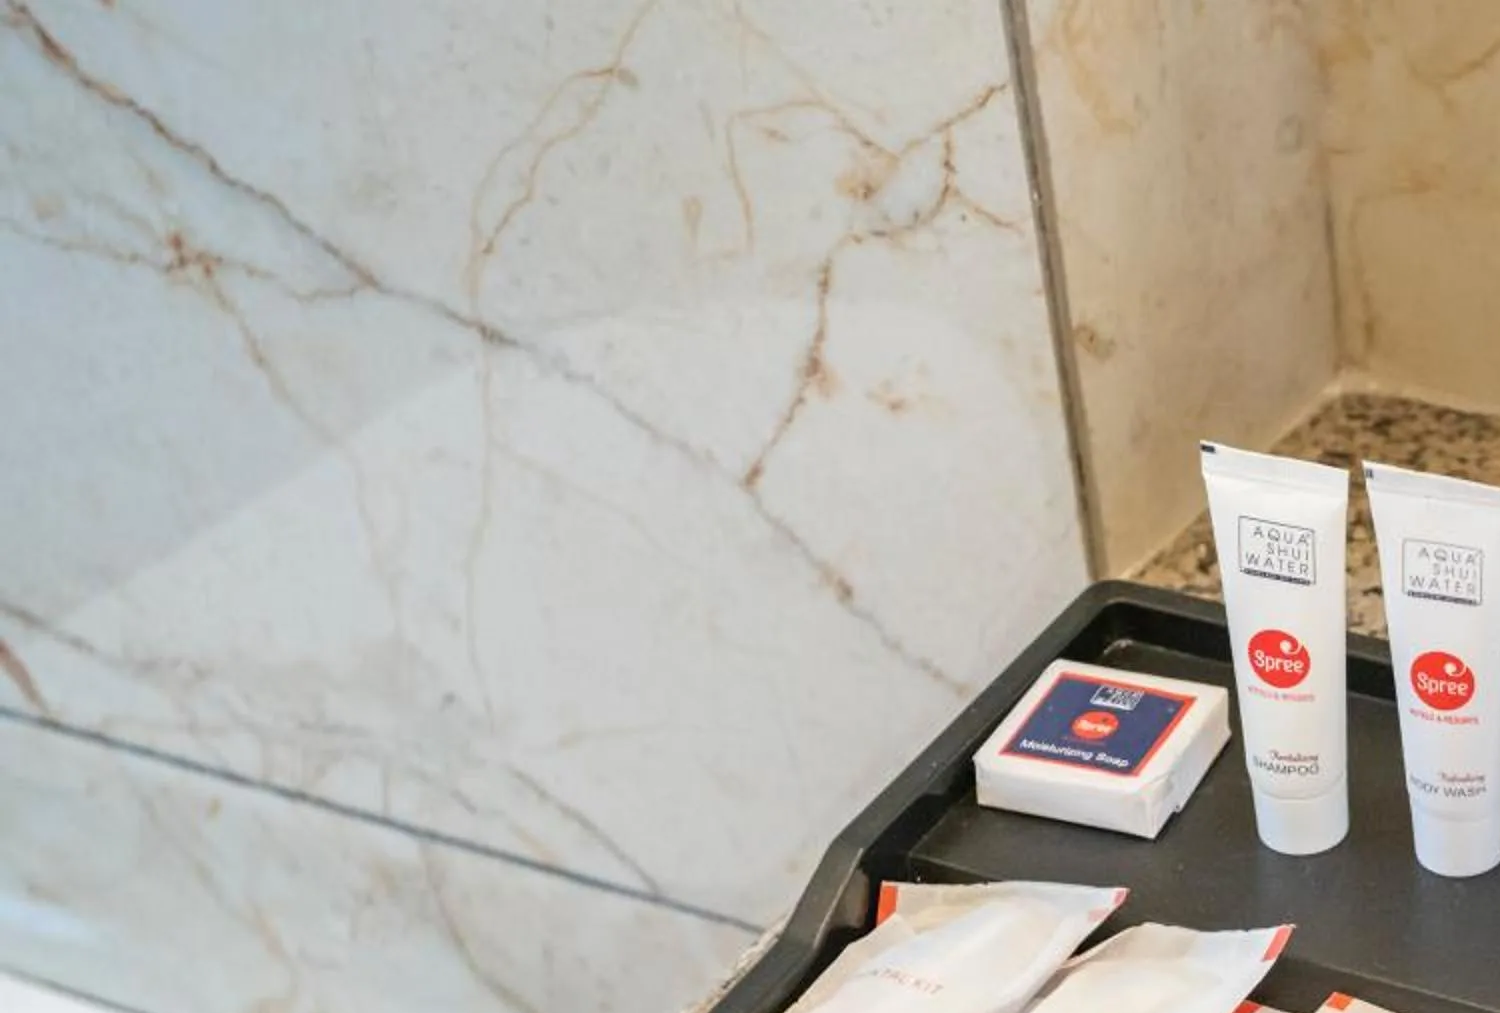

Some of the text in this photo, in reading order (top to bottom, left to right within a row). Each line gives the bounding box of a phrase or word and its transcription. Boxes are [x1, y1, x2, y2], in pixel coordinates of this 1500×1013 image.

[1252, 525, 1309, 546] AQUA
[1266, 541, 1309, 561] SHUI
[1418, 547, 1476, 565] AQUA
[1244, 551, 1309, 577] WATER
[1433, 562, 1477, 581] SHUI
[1408, 575, 1477, 596] WATER
[1254, 649, 1305, 673] Spree
[1416, 671, 1469, 697] Spree
